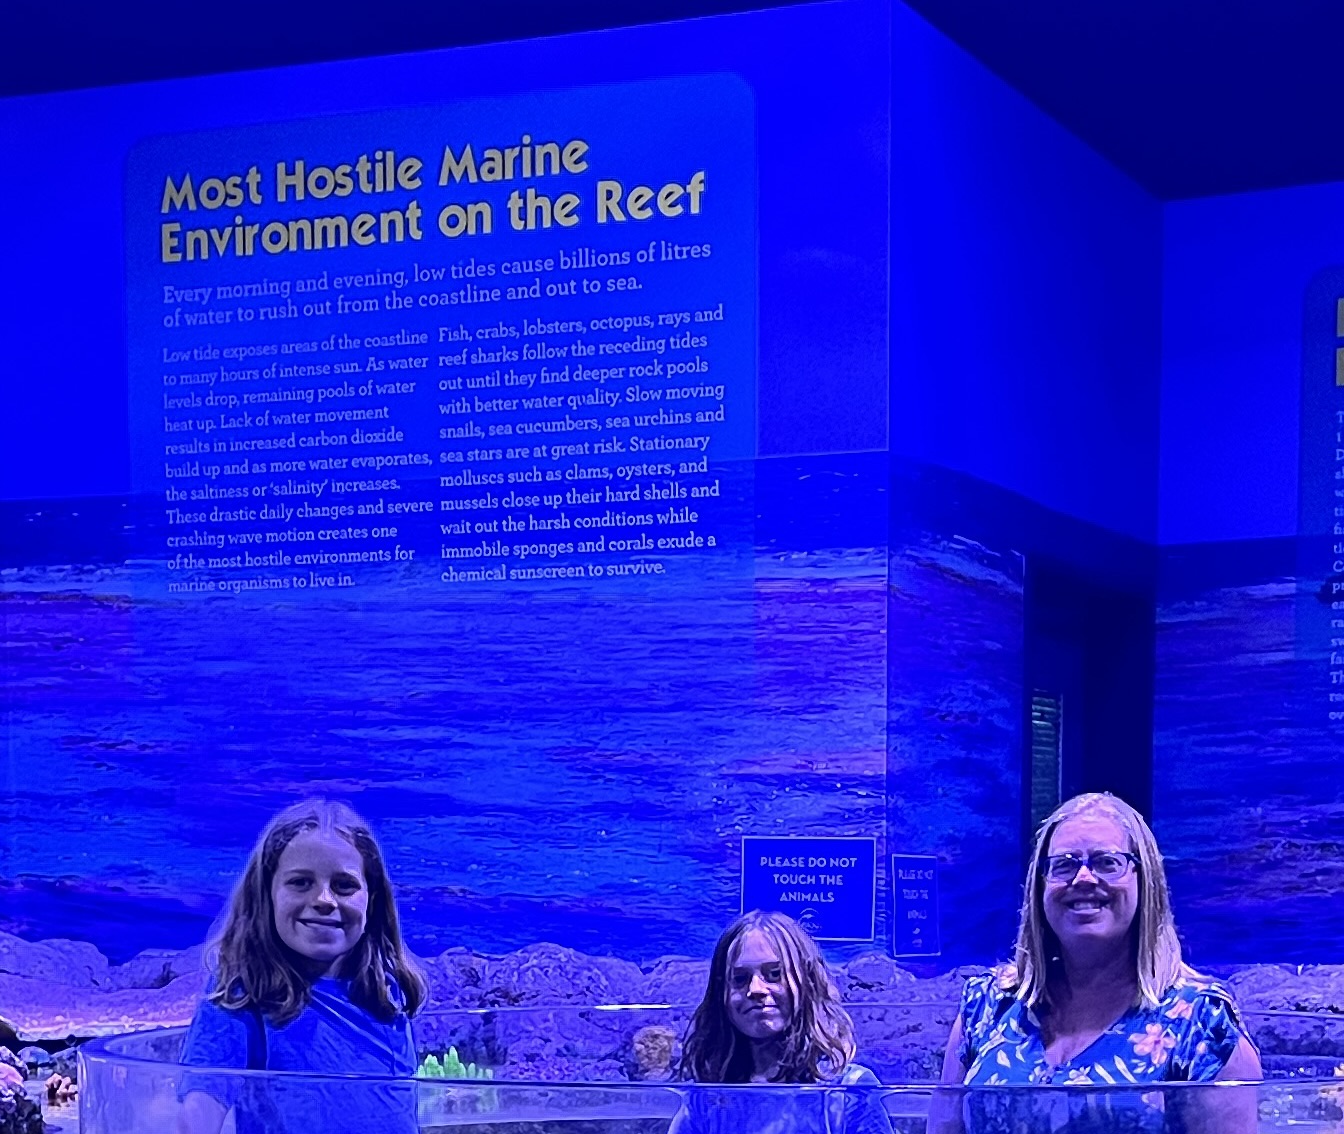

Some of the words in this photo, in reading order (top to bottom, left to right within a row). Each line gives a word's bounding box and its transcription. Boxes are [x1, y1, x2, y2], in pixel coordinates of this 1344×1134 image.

[161, 166, 262, 212] Most
[277, 151, 423, 202] Hostile
[439, 135, 590, 185] Marine
[162, 201, 423, 262] Environment
[439, 203, 492, 238] on
[507, 188, 581, 230] the
[597, 172, 705, 222] Reef
[163, 286, 212, 305] Every
[217, 279, 291, 299] morning
[296, 271, 328, 292] and
[333, 269, 408, 289] evening,
[414, 263, 445, 282] low
[451, 258, 495, 279] tides
[501, 259, 554, 274] cause
[560, 248, 630, 269] billions
[636, 242, 655, 263] of
[661, 241, 711, 261] litres
[163, 308, 181, 327] of
[184, 310, 233, 325] water
[237, 307, 254, 322] to
[259, 299, 298, 320] rush
[303, 301, 331, 316] out
[337, 295, 379, 314] from
[385, 290, 413, 309] the
[418, 284, 501, 306] coastline
[507, 278, 541, 300] and
[546, 280, 576, 296] out
[583, 279, 601, 294] to
[607, 277, 642, 291] sea.
[439, 324, 473, 342] Fish,
[476, 322, 520, 339] crabs,
[523, 318, 587, 335] lobsters,
[590, 316, 654, 332] octopus,
[658, 312, 691, 328] rays
[695, 303, 724, 322] and
[439, 348, 468, 366] reef
[471, 346, 519, 364] sharks
[523, 342, 568, 360] follow
[571, 340, 595, 356] the
[599, 335, 666, 354] receding
[670, 331, 707, 349] tides
[439, 377, 463, 390] out
[466, 370, 501, 388] until
[504, 369, 537, 388] they
[541, 366, 570, 383] find
[573, 364, 626, 383] deeper
[629, 359, 663, 377] rock
[667, 356, 708, 378] pools
[439, 397, 471, 414] with
[474, 396, 519, 412] better
[522, 396, 564, 409] water
[567, 388, 622, 410] quality.
[626, 385, 662, 402] Slow
[666, 385, 724, 400] moving
[165, 461, 200, 478] build
[203, 465, 220, 479] up
[224, 459, 249, 475] and
[252, 463, 267, 473] as
[270, 461, 306, 472] more
[309, 458, 348, 470] water
[351, 454, 433, 470] evaporates,
[166, 508, 206, 524] These
[210, 506, 256, 522] drastic
[260, 503, 294, 522] daily
[296, 502, 354, 520] changes
[358, 498, 384, 515] and
[387, 502, 434, 513] severe
[441, 493, 498, 510] mussels
[502, 491, 540, 508] close
[543, 495, 562, 509] up
[566, 488, 602, 504] their
[605, 484, 640, 502] hard
[644, 482, 687, 500] shells
[691, 480, 720, 497] and
[760, 857, 805, 867] PLEASE
[808, 857, 827, 867] DO
[829, 857, 857, 868] NOT
[773, 873, 816, 885] TOUCH
[819, 875, 843, 886] THE
[779, 892, 835, 903] ANIMALS
